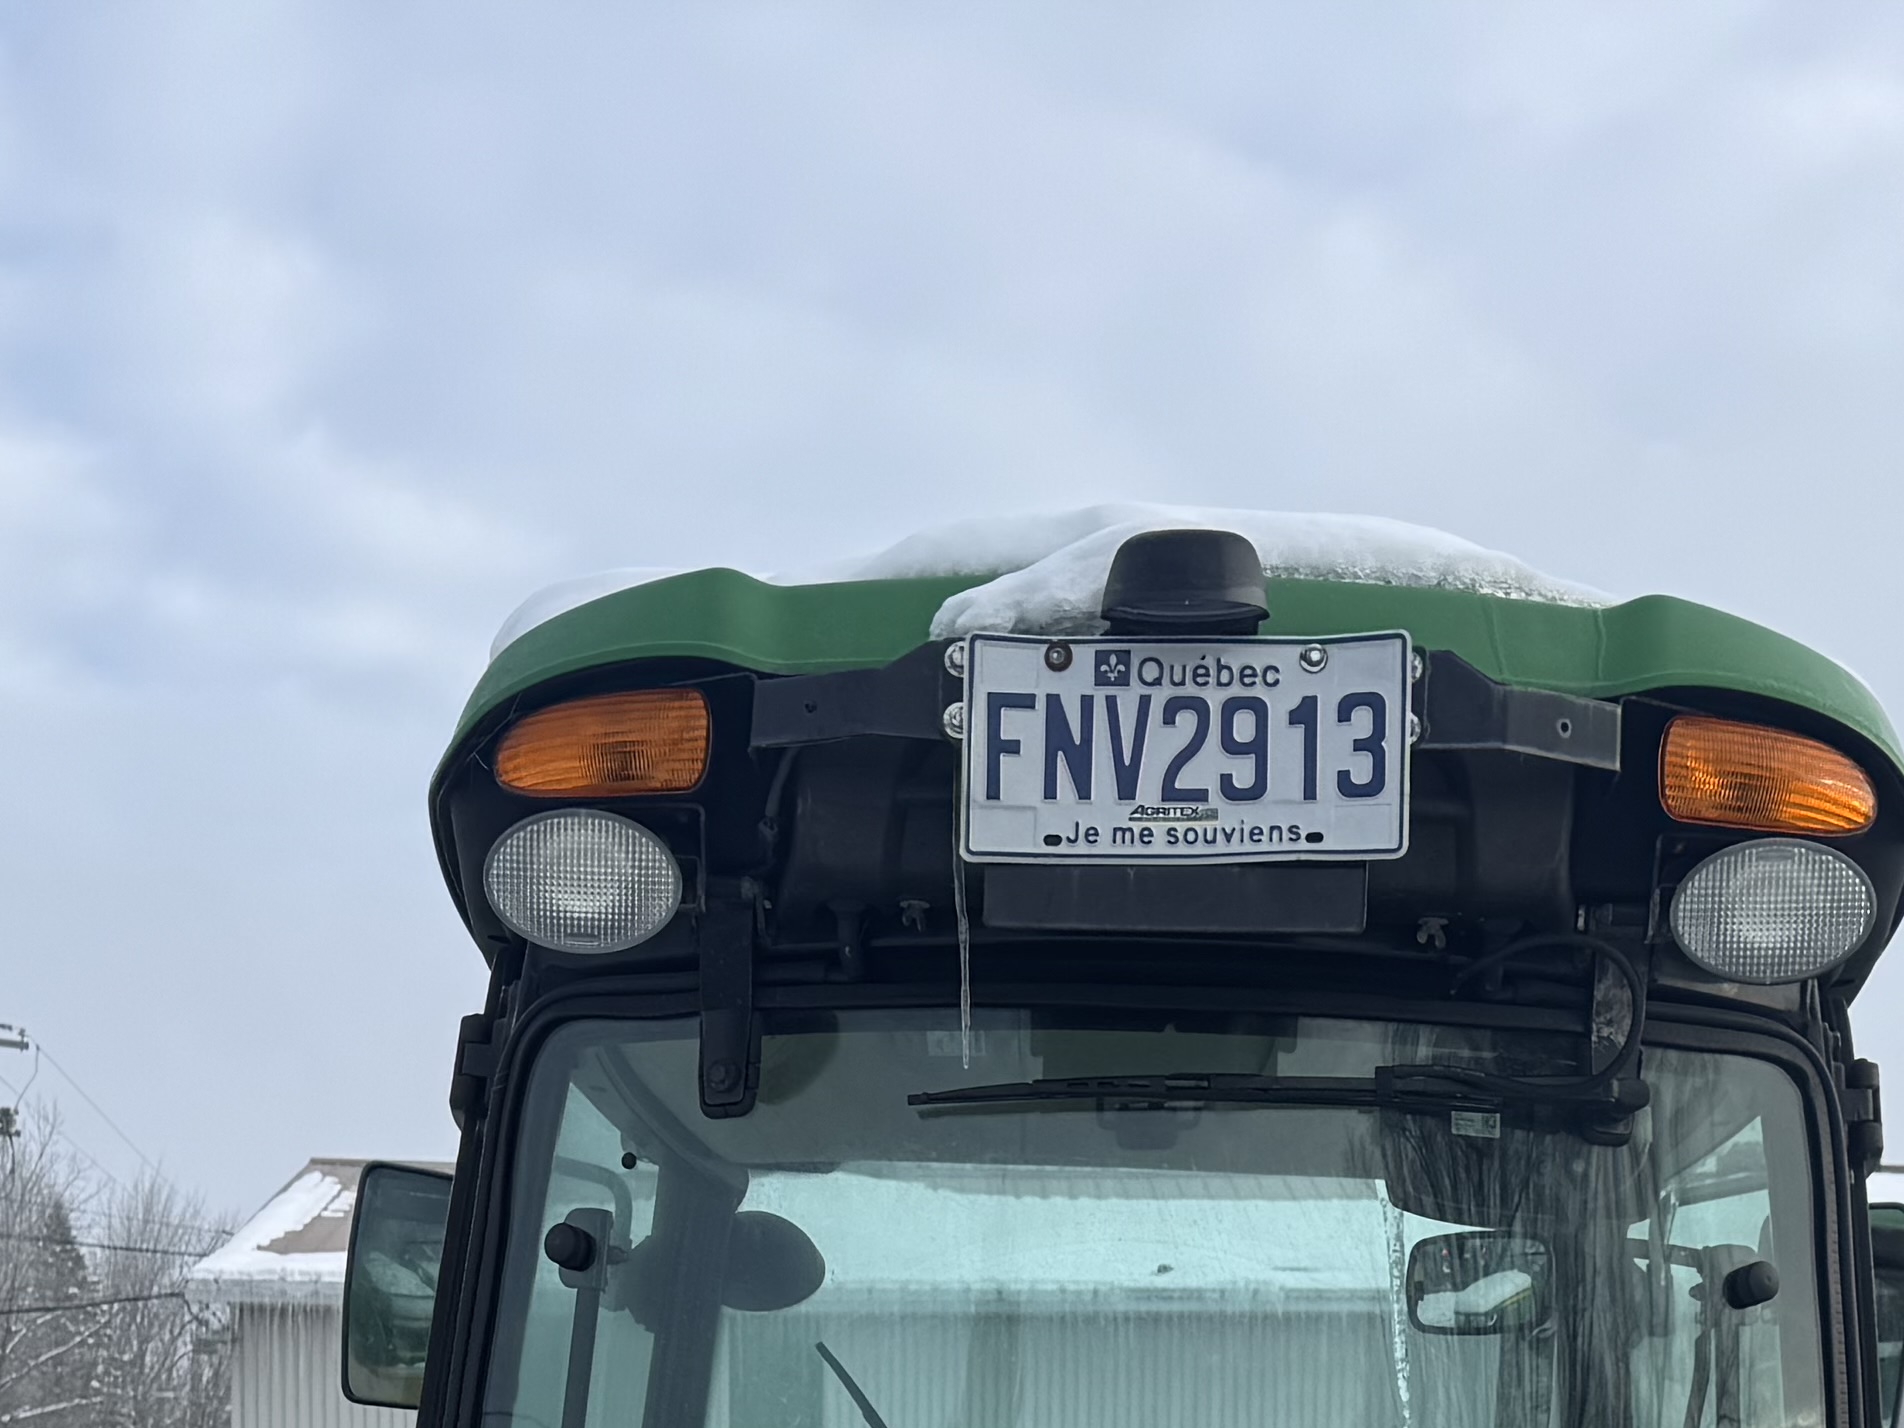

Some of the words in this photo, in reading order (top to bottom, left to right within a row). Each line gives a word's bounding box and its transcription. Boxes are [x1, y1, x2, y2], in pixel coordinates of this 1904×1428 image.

[1137, 655, 1281, 688] Québec
[985, 691, 1388, 802] FNV2913
[1129, 804, 1200, 817] AGRITEX
[1065, 821, 1100, 845] Je
[1111, 826, 1155, 845] me
[1166, 821, 1302, 845] souviens
